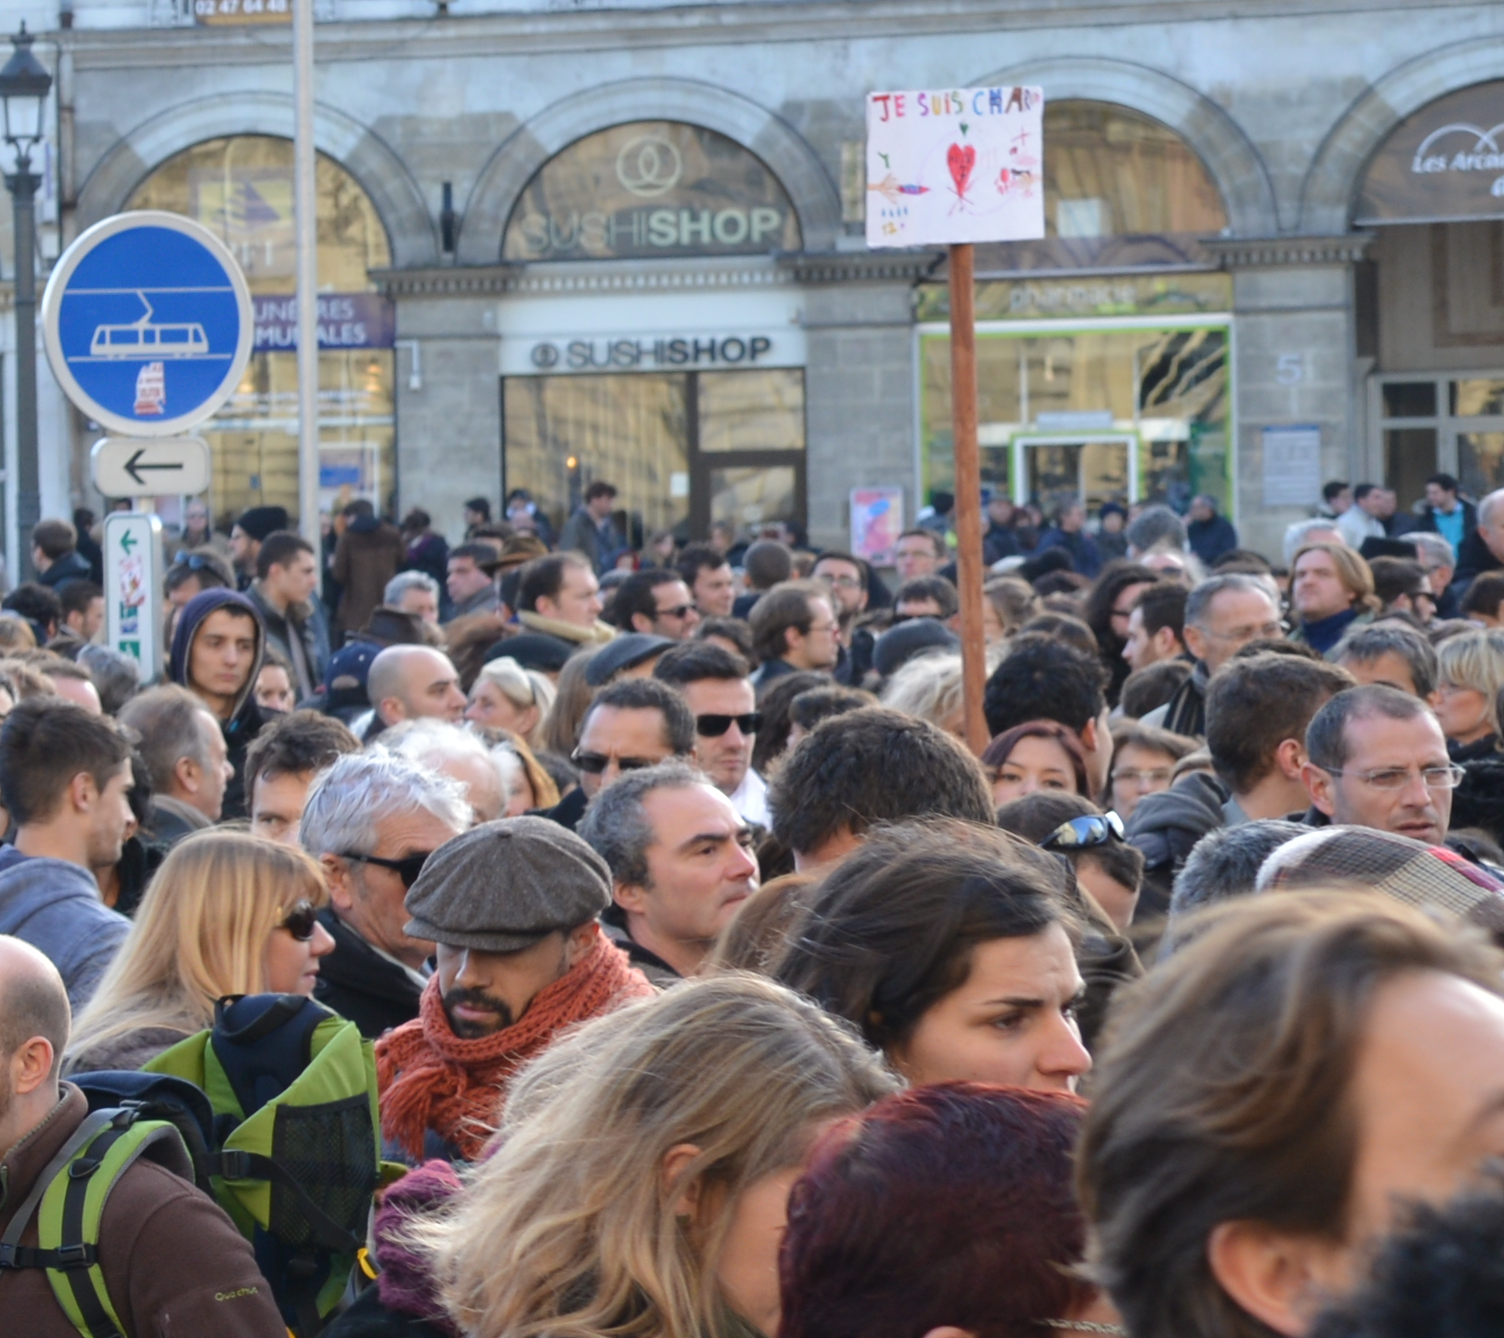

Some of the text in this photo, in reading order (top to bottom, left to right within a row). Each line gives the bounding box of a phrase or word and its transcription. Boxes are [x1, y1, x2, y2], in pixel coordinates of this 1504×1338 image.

[872, 94, 905, 122] JE
[918, 91, 964, 117] SUIS
[1412, 154, 1448, 173] Les
[1277, 354, 1302, 384] 5
